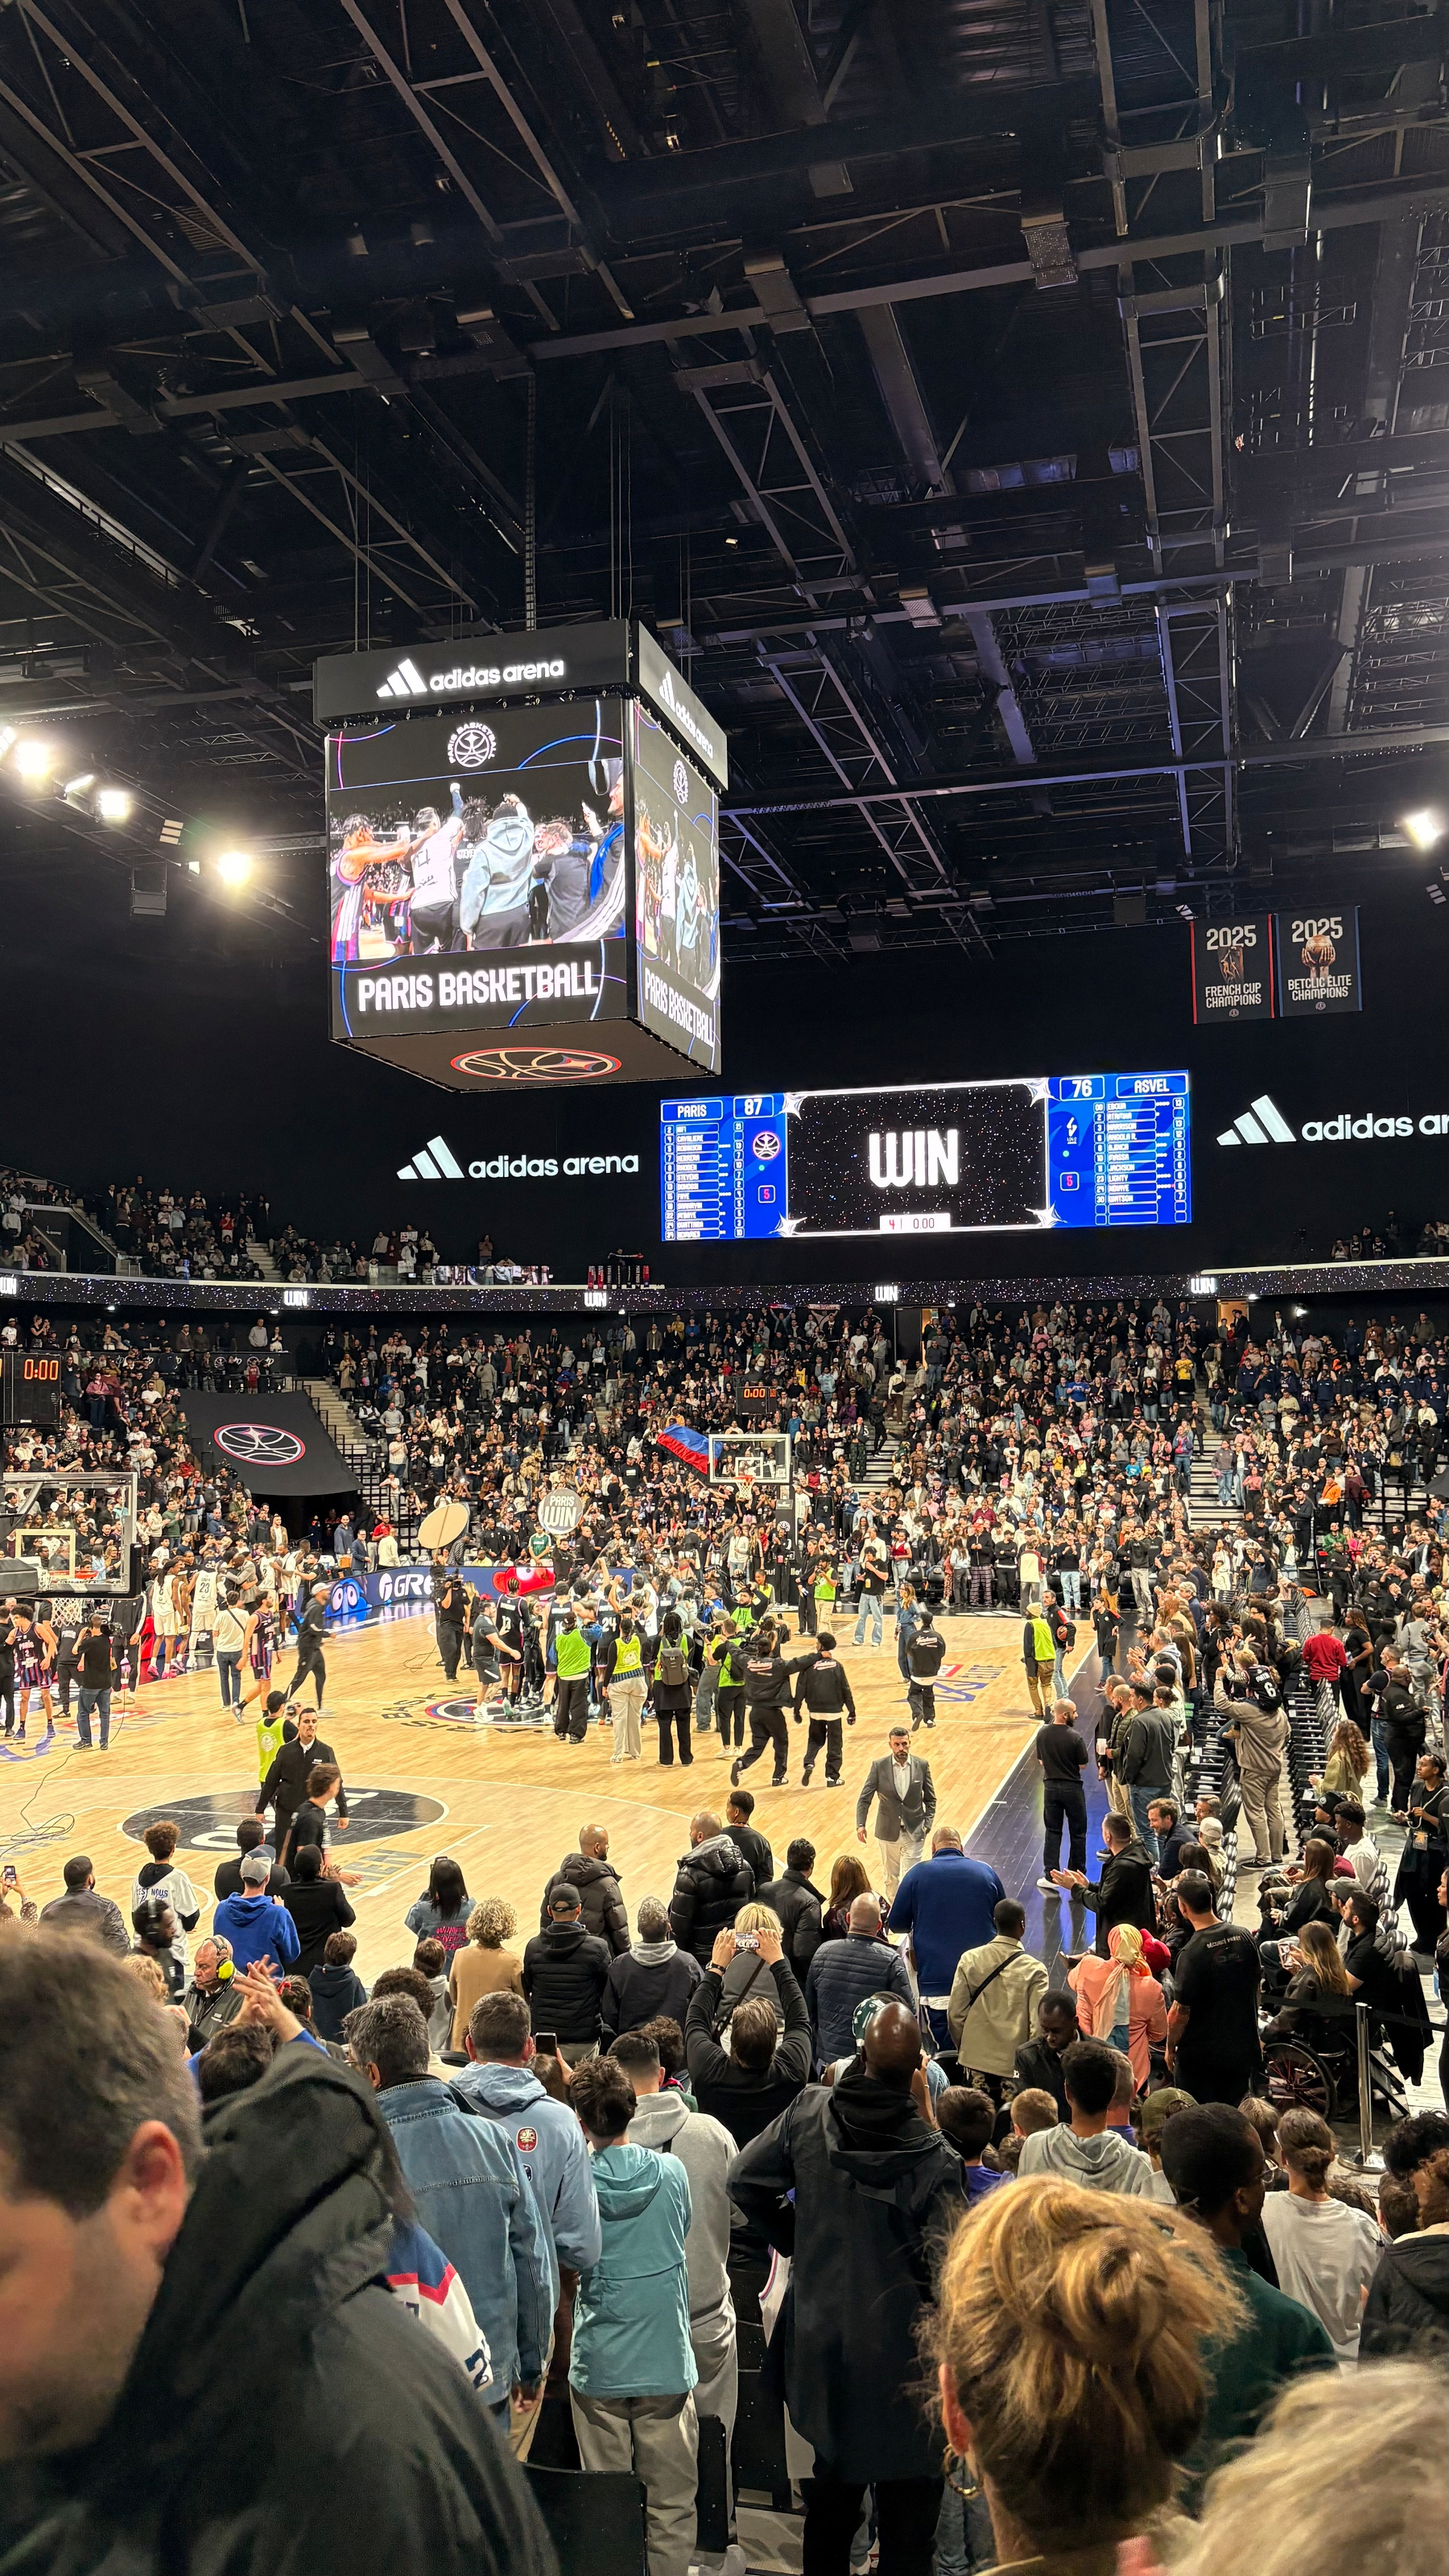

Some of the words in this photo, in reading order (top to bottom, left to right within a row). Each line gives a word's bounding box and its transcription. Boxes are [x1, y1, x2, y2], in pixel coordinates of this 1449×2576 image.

[430, 667, 501, 691] adidas
[502, 660, 564, 682] arena
[676, 701, 696, 737] adidas
[696, 728, 713, 759] arena
[1206, 924, 1257, 951] 2025
[1291, 916, 1344, 943] 2025
[358, 974, 433, 1012] PARIS
[439, 960, 599, 1006] BASKETBALL
[1205, 984, 1241, 998] FRENCH
[1243, 982, 1261, 995] CUP
[1288, 977, 1326, 991] BETCLIC
[1327, 974, 1352, 988] ÉLITE
[1206, 993, 1262, 1009] CHAMPIONS
[1291, 985, 1349, 1001] CHAMPIONS
[645, 967, 668, 1014] PARIS
[668, 987, 715, 1048] BASKETBALL
[1071, 1080, 1092, 1098] 76
[1134, 1078, 1170, 1094] ASVEL
[677, 1104, 707, 1119] PARIS
[745, 1098, 763, 1116] 87
[1097, 1113, 1102, 1121] 2
[1301, 1113, 1414, 1141] adidas
[469, 1154, 559, 1179] adidas
[563, 1154, 639, 1176] arena
[869, 1129, 958, 1188] WIN
[737, 1170, 741, 1179] 7
[1108, 1163, 1135, 1172] JACKSON
[1066, 1174, 1073, 1187] 5
[1108, 1174, 1129, 1183] LIGHTY
[763, 1188, 770, 1200] 5
[1096, 1195, 1105, 1203] 30
[889, 1219, 895, 1230] 4
[913, 1217, 935, 1229] 0.00
[875, 1286, 898, 1302] WIN
[1191, 1278, 1216, 1294] WIN
[284, 1290, 308, 1307] WIN
[584, 1292, 607, 1307] WIN
[24, 1359, 59, 1381] 0:00
[743, 1388, 766, 1398] 0:00
[550, 1495, 576, 1507] PARIS
[543, 1505, 577, 1528] WIN
[199, 1582, 210, 1594] 23
[602, 1616, 617, 1633] 24
[1264, 1682, 1277, 1698] 6
[151, 1888, 168, 1898] NOUS
